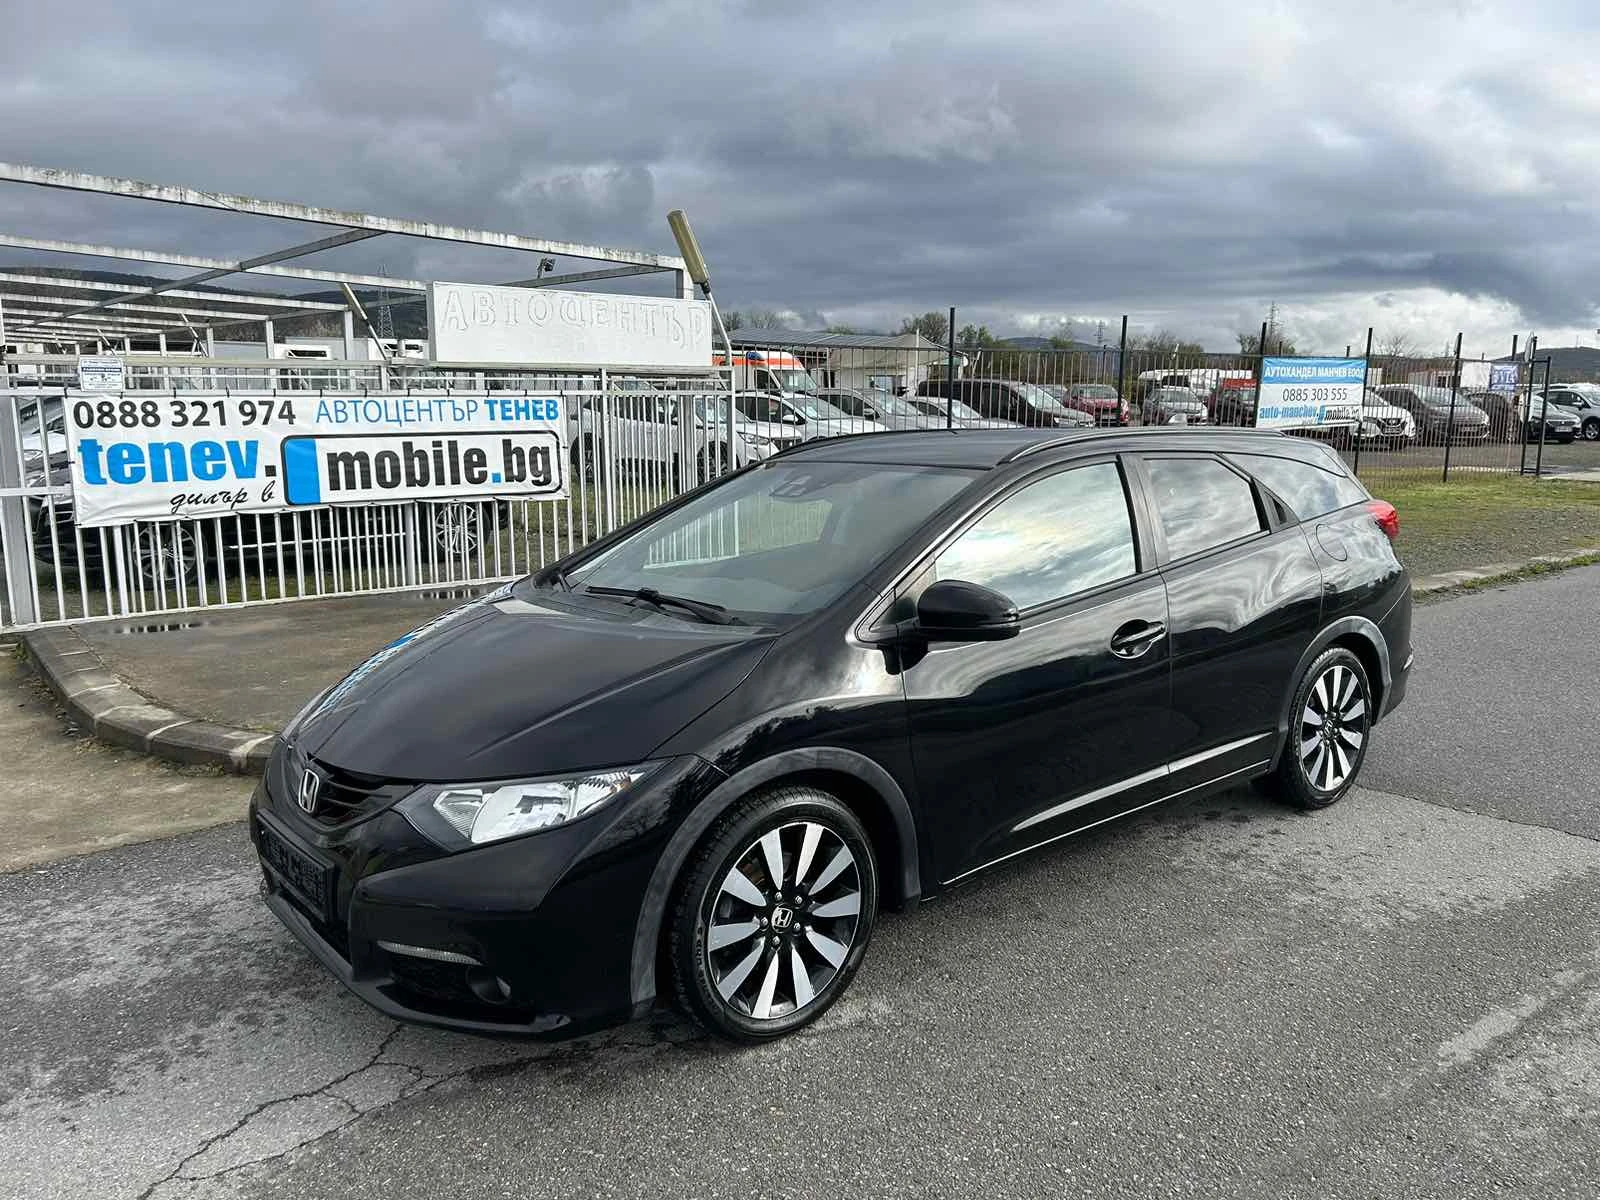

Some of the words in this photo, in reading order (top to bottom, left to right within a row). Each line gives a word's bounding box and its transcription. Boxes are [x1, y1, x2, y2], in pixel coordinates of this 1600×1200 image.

[440, 288, 708, 348] АВТОЦЕНТЪР
[1264, 366, 1317, 378] АУТОХАНДЕЛ
[1317, 366, 1347, 378] МАНЧЕВ
[1282, 387, 1309, 402] 0885
[1310, 387, 1329, 401] 303
[1331, 387, 1348, 401] 555
[73, 400, 161, 429] 0888
[169, 399, 228, 427] 321
[238, 399, 297, 426] 974
[315, 398, 479, 426] АВТОЦЕНТЪР
[484, 399, 560, 421] ТЕНЕВ
[326, 438, 552, 491] mobile.bg
[169, 487, 248, 514] дилър
[260, 479, 277, 503] в
